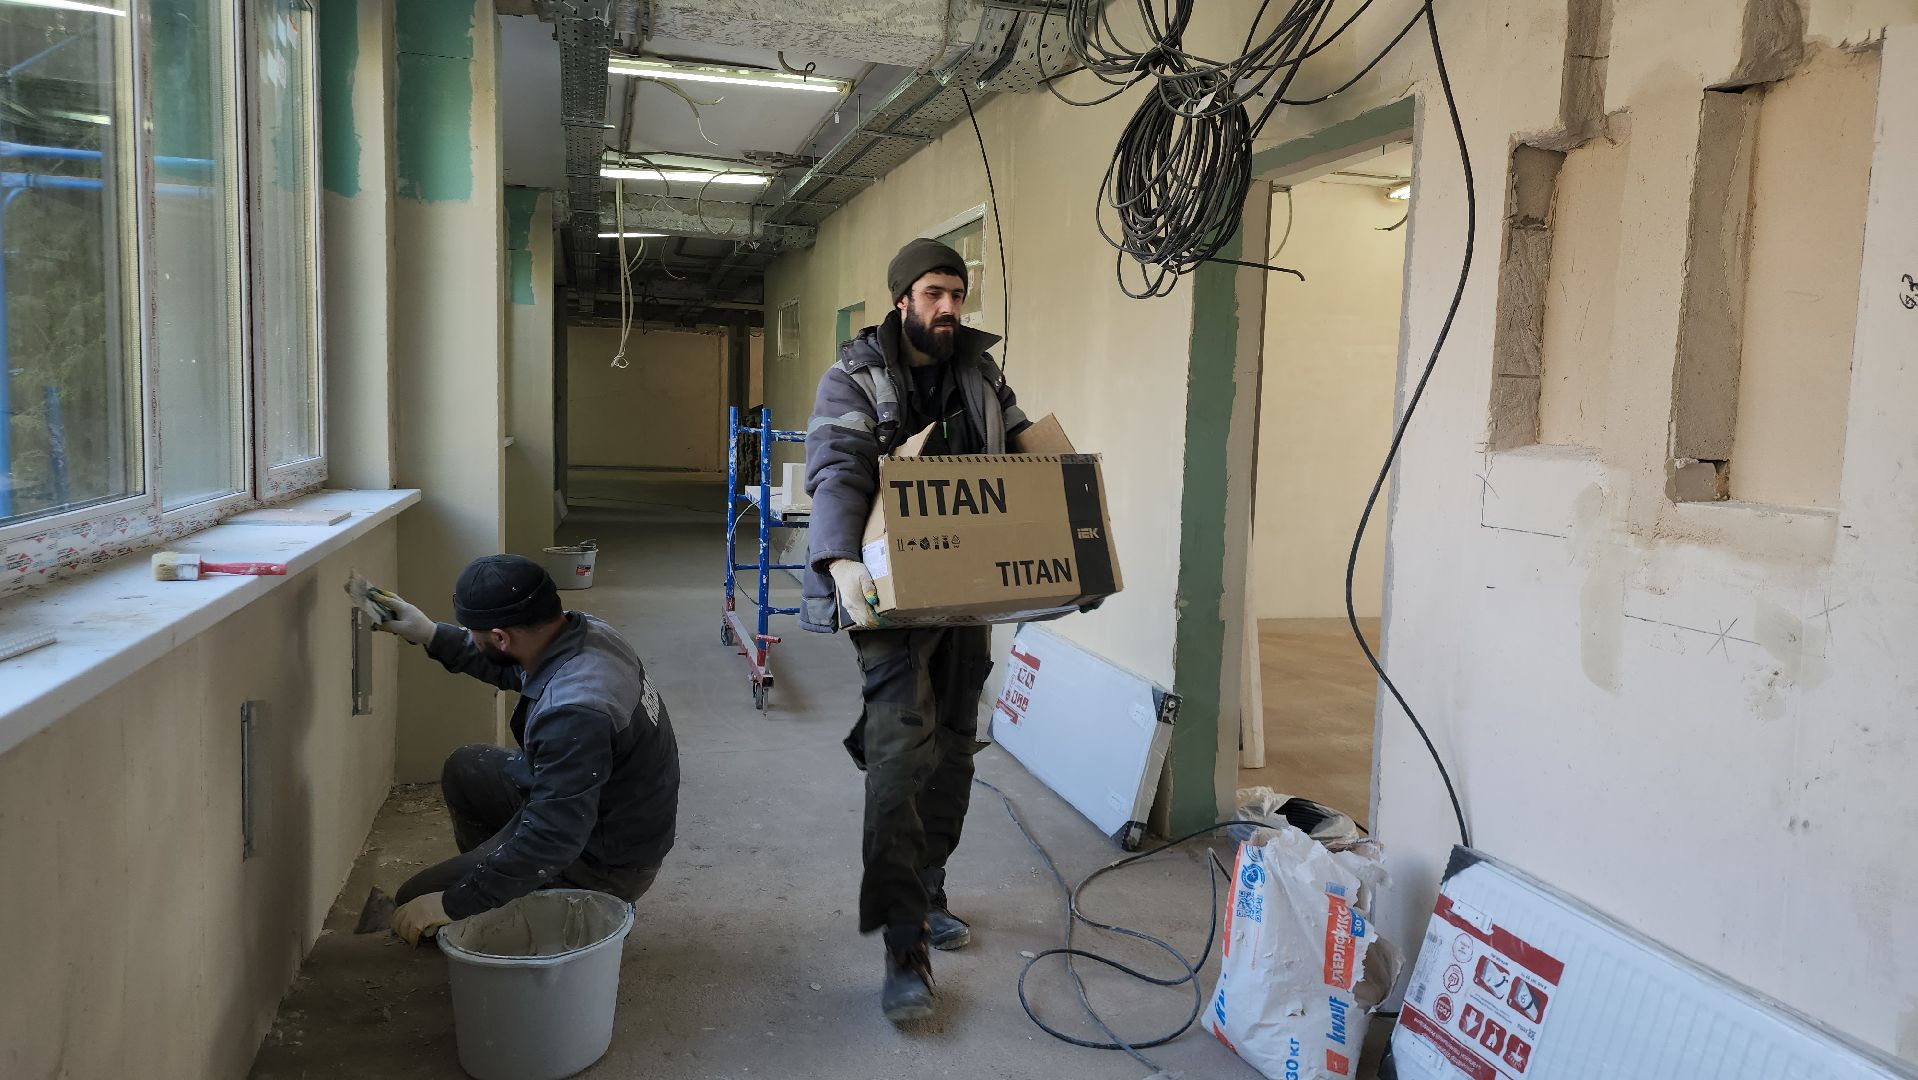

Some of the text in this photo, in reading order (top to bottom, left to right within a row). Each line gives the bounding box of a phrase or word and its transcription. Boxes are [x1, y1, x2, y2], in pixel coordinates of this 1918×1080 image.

[889, 478, 1007, 517] TITAN
[995, 558, 1073, 587] TITAN
[1286, 1059, 1299, 1080] 30
